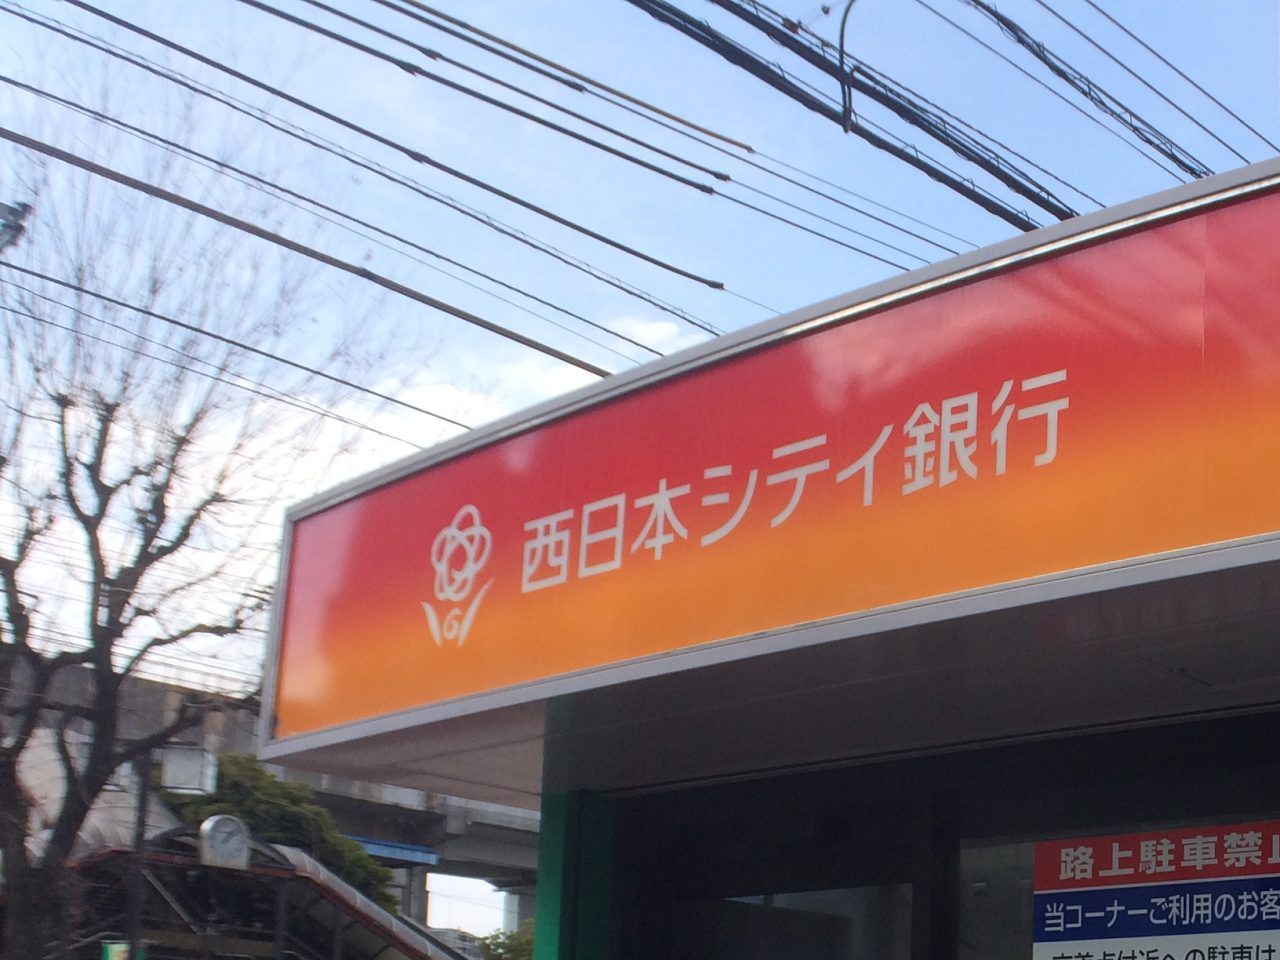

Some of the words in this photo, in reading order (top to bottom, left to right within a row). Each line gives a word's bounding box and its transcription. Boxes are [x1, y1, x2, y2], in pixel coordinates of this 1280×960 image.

[520, 368, 1069, 593] 西日本シティ銀行
